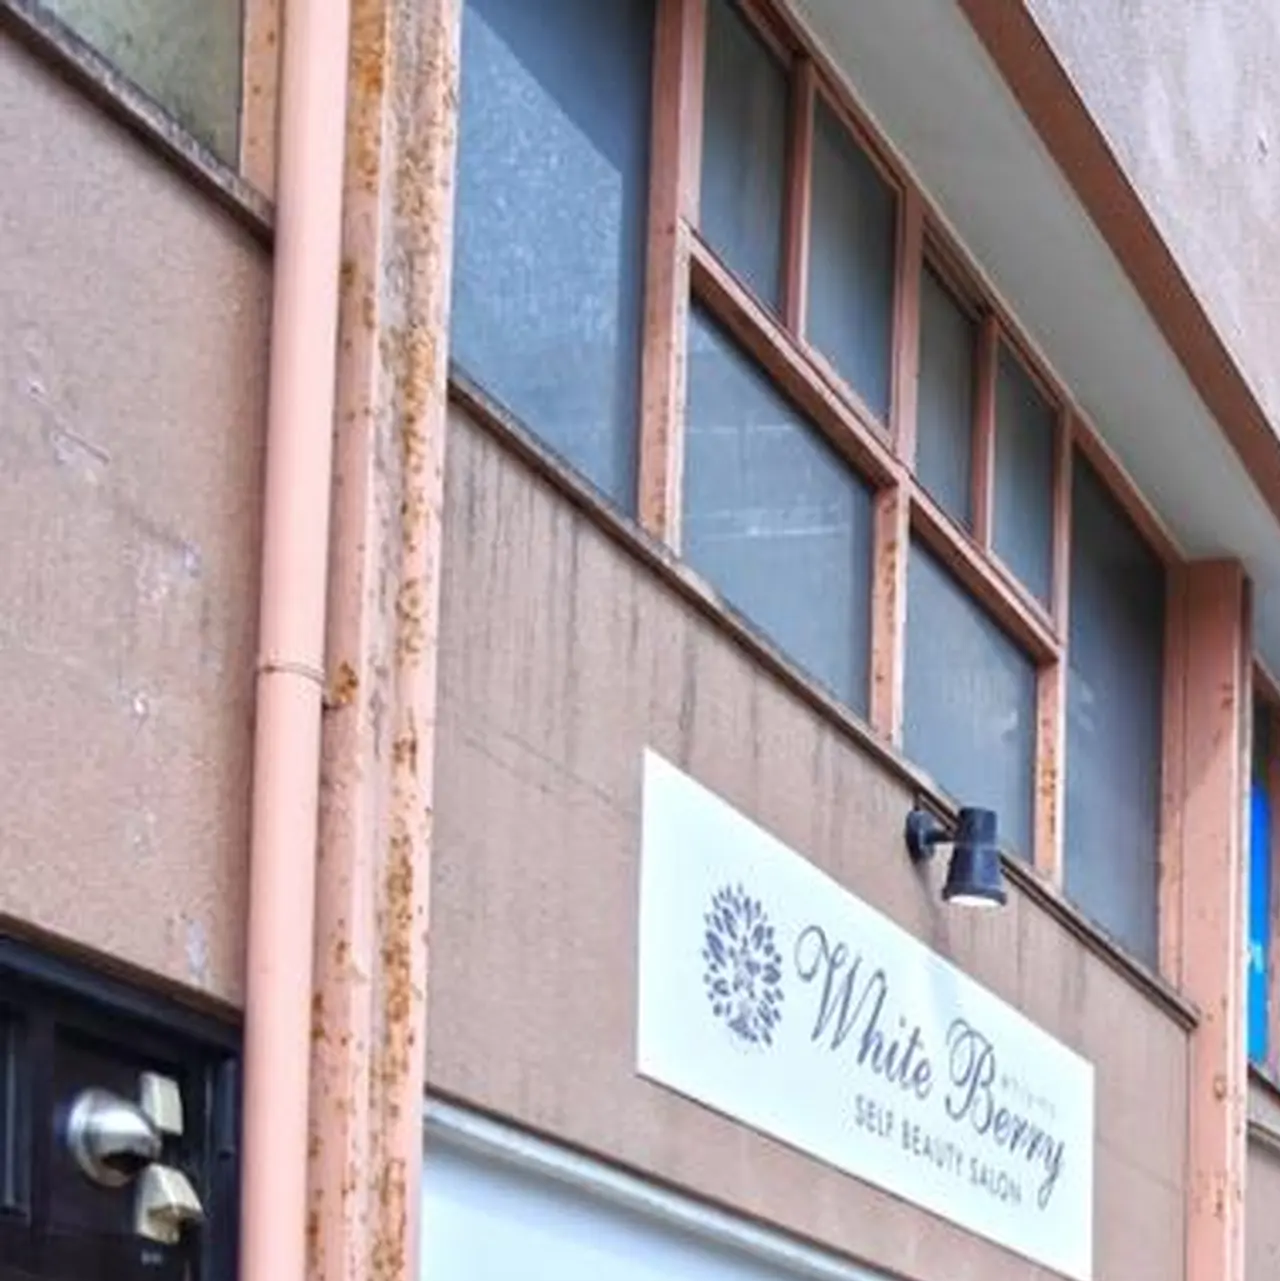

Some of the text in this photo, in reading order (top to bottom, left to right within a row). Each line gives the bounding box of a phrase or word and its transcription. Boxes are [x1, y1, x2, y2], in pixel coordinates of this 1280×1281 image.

[795, 924, 1065, 1210] White Berry
[855, 1093, 1023, 1203] SELF BEAUTY SALON
